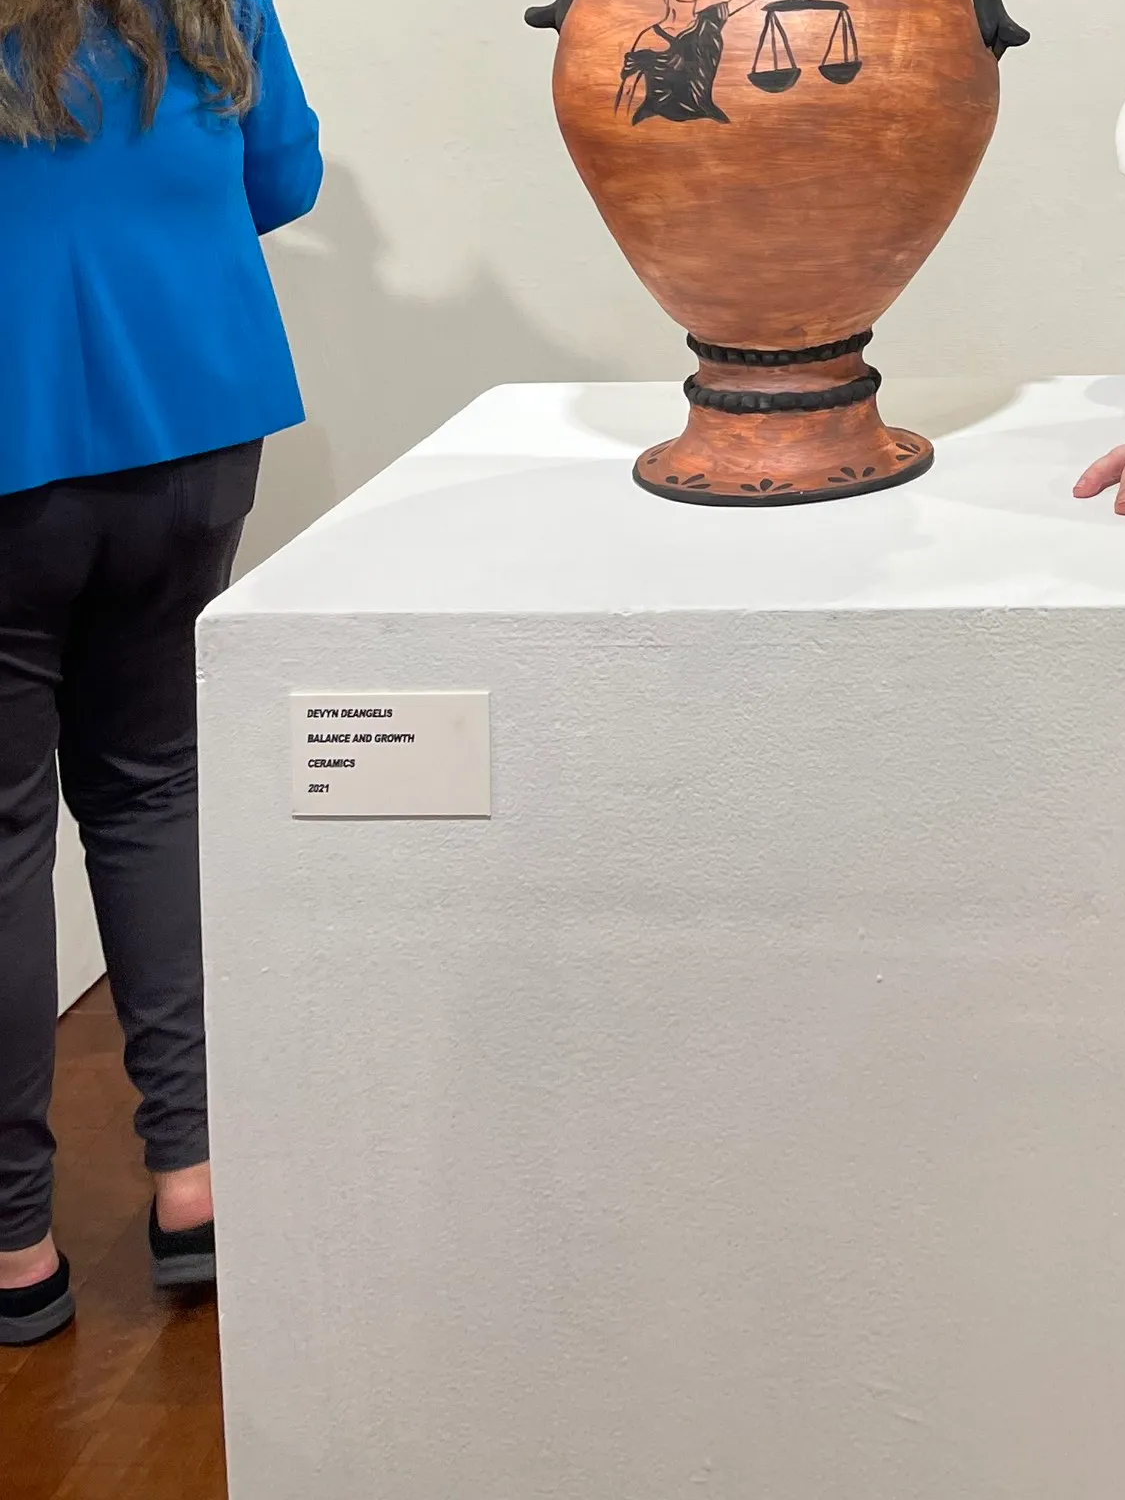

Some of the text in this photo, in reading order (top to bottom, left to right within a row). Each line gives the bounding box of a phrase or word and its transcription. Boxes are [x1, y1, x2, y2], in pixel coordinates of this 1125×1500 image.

[306, 708, 393, 718] DEVYN DEANGELIS
[307, 733, 415, 743] BALANCE AND GROWTH
[307, 758, 356, 768] CERAMICS
[307, 783, 330, 793] 2021
